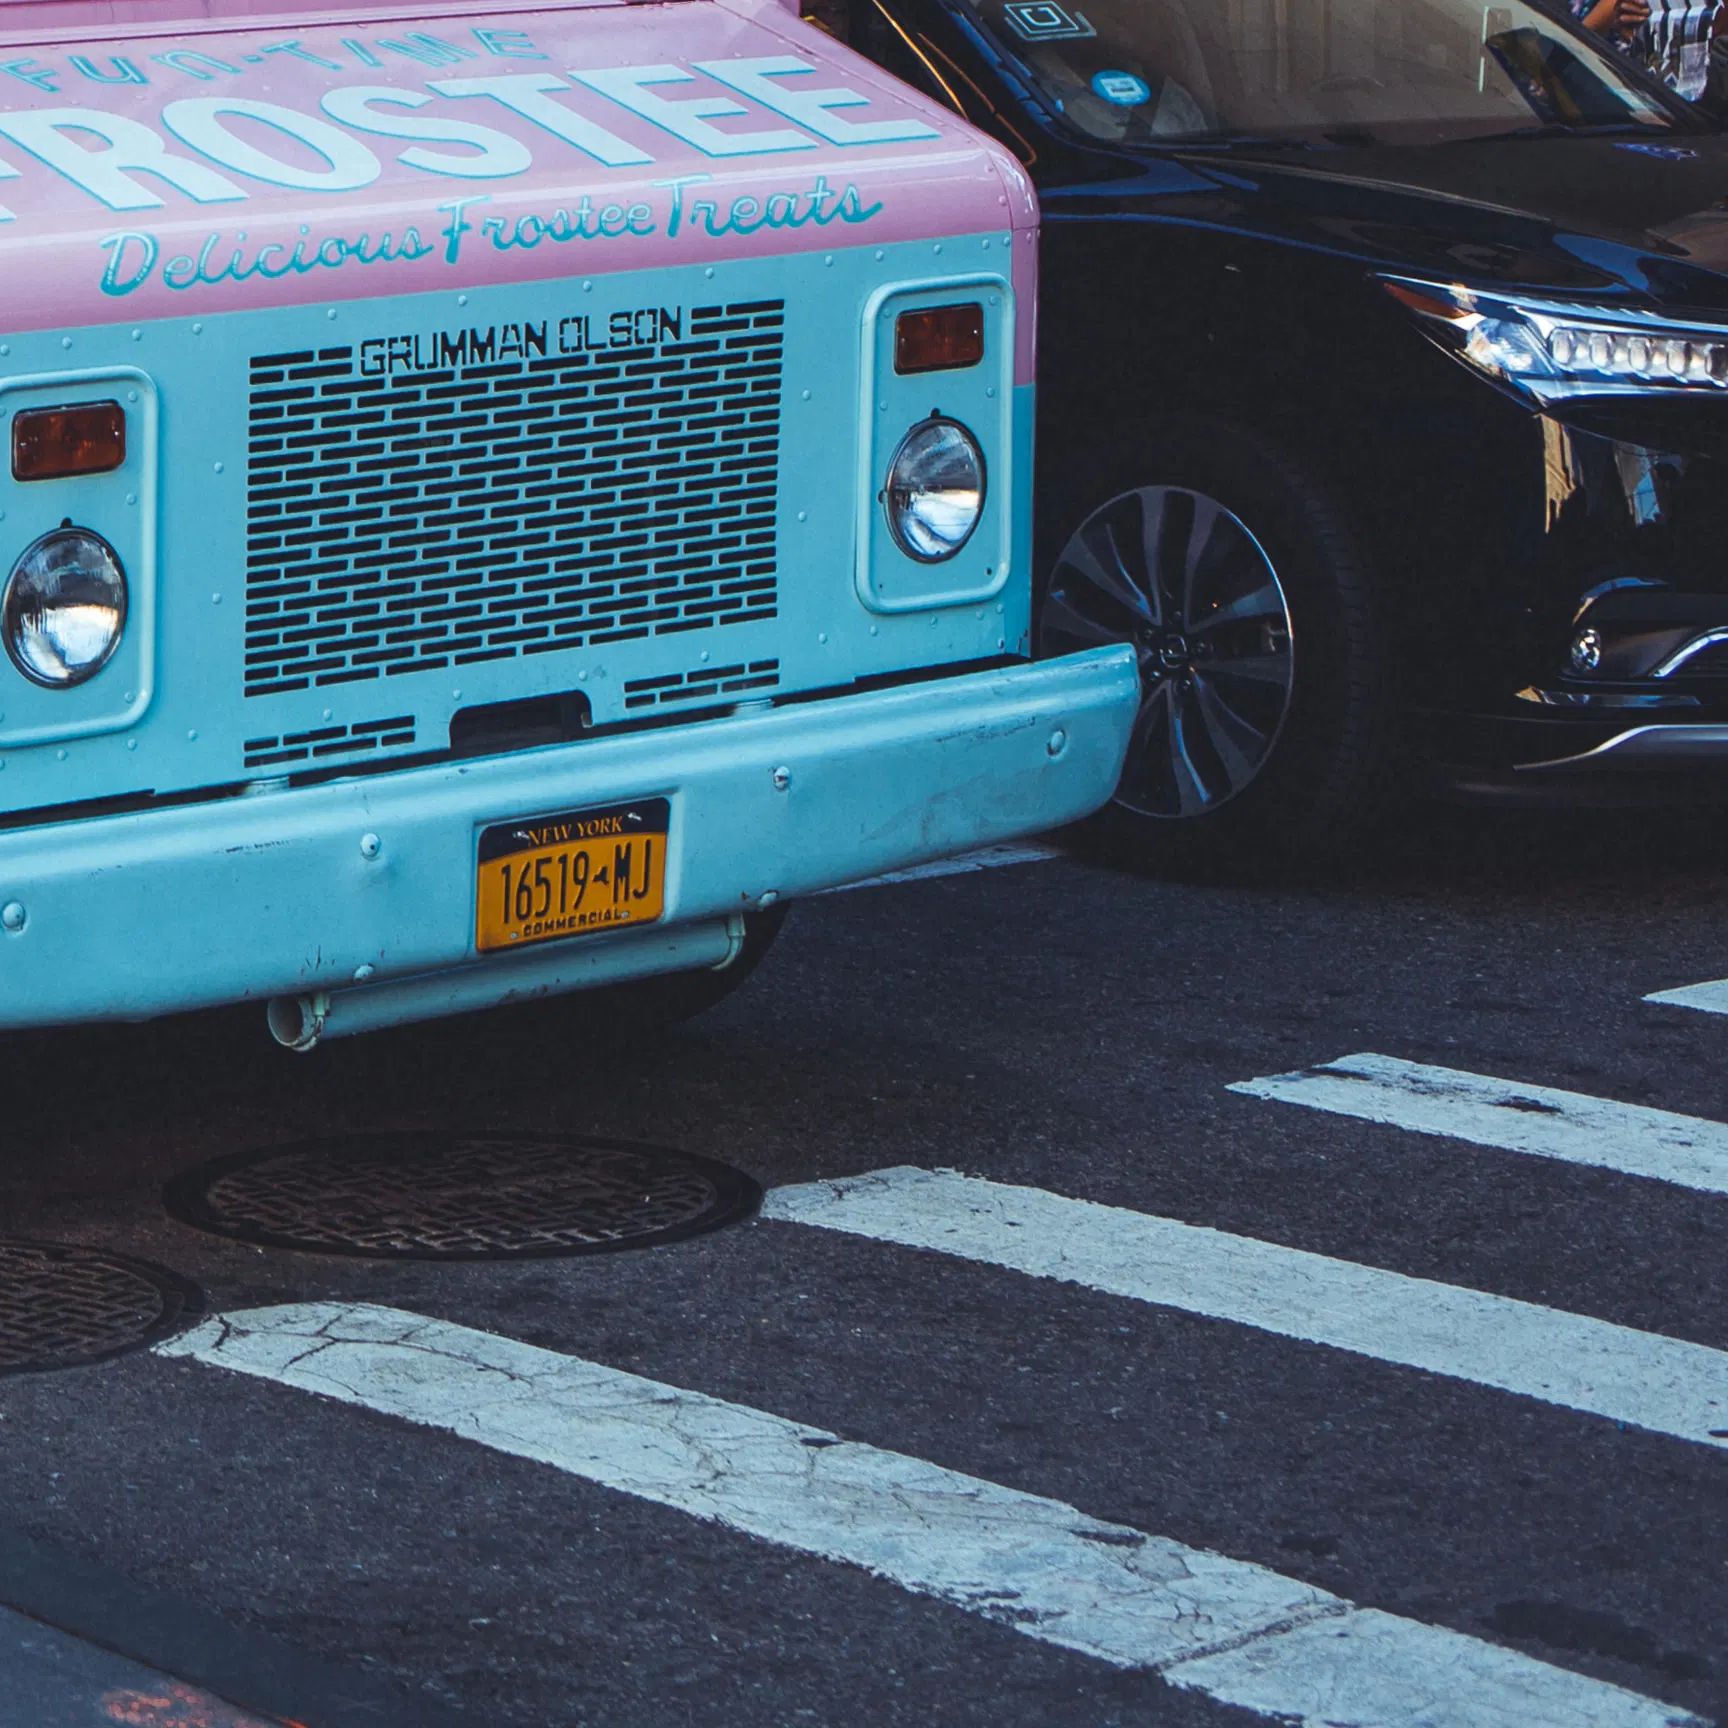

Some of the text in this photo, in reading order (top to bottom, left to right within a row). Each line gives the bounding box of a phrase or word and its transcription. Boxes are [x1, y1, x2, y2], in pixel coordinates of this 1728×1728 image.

[98, 174, 884, 297] Delicious Frostee Treats
[360, 306, 682, 377] GRUMMAN OLSON
[528, 816, 623, 848] NEW YORK
[523, 908, 622, 937] COMMERCIAL
